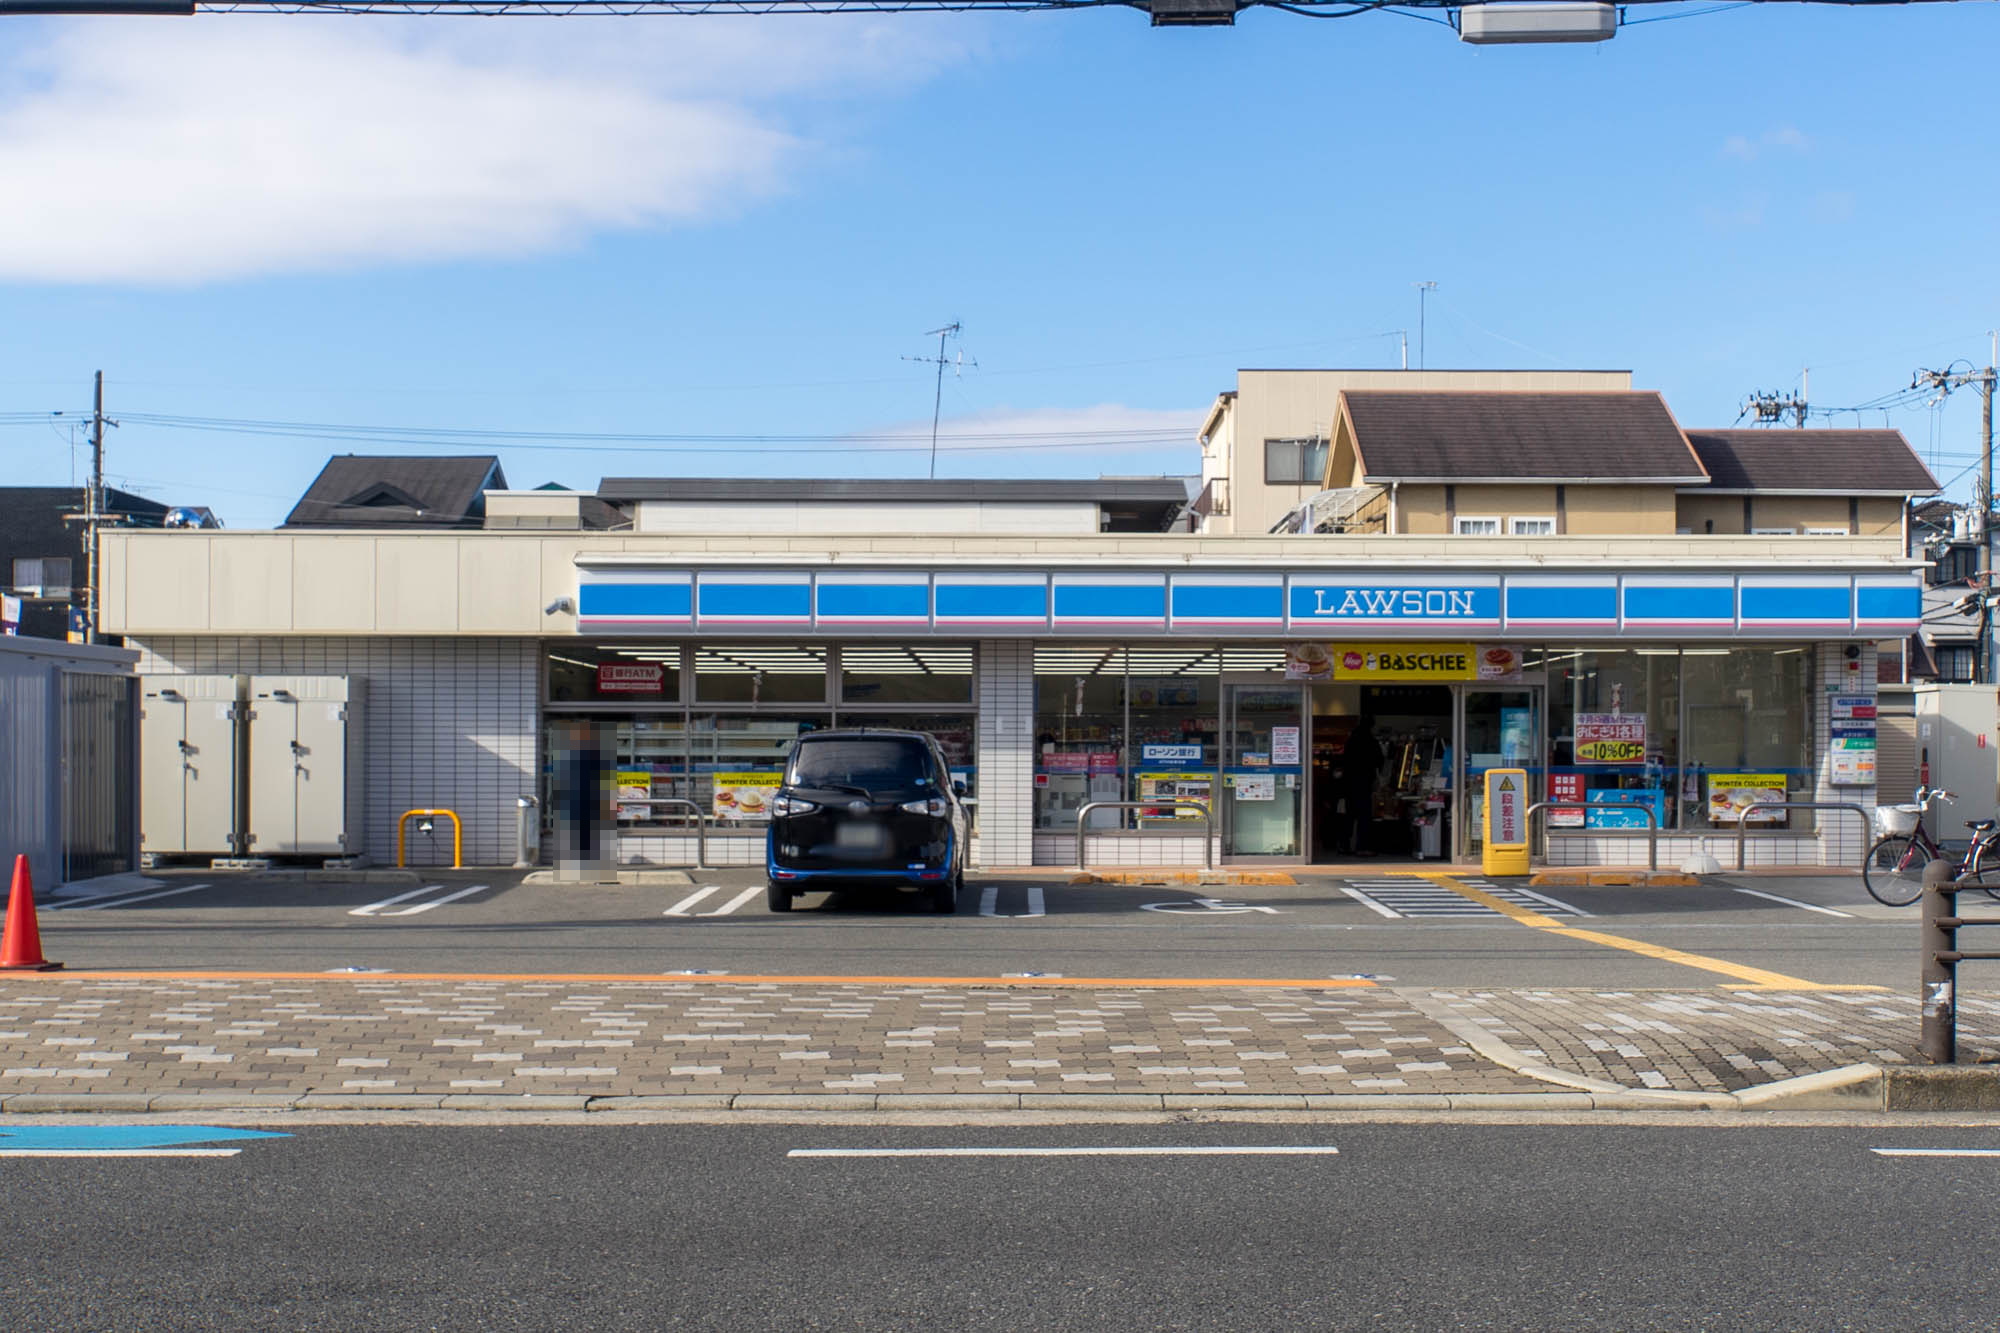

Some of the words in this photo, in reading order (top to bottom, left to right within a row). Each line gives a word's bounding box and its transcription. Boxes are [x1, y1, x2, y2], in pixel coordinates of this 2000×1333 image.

[1314, 590, 1475, 615] LAWSON
[1379, 654, 1466, 671] BASCHEE
[1576, 726, 1643, 738] おにぎり各種
[1149, 748, 1196, 756] ローソン銀行
[1593, 743, 1643, 760] 10%OFF
[1502, 793, 1514, 841] 段差注意
